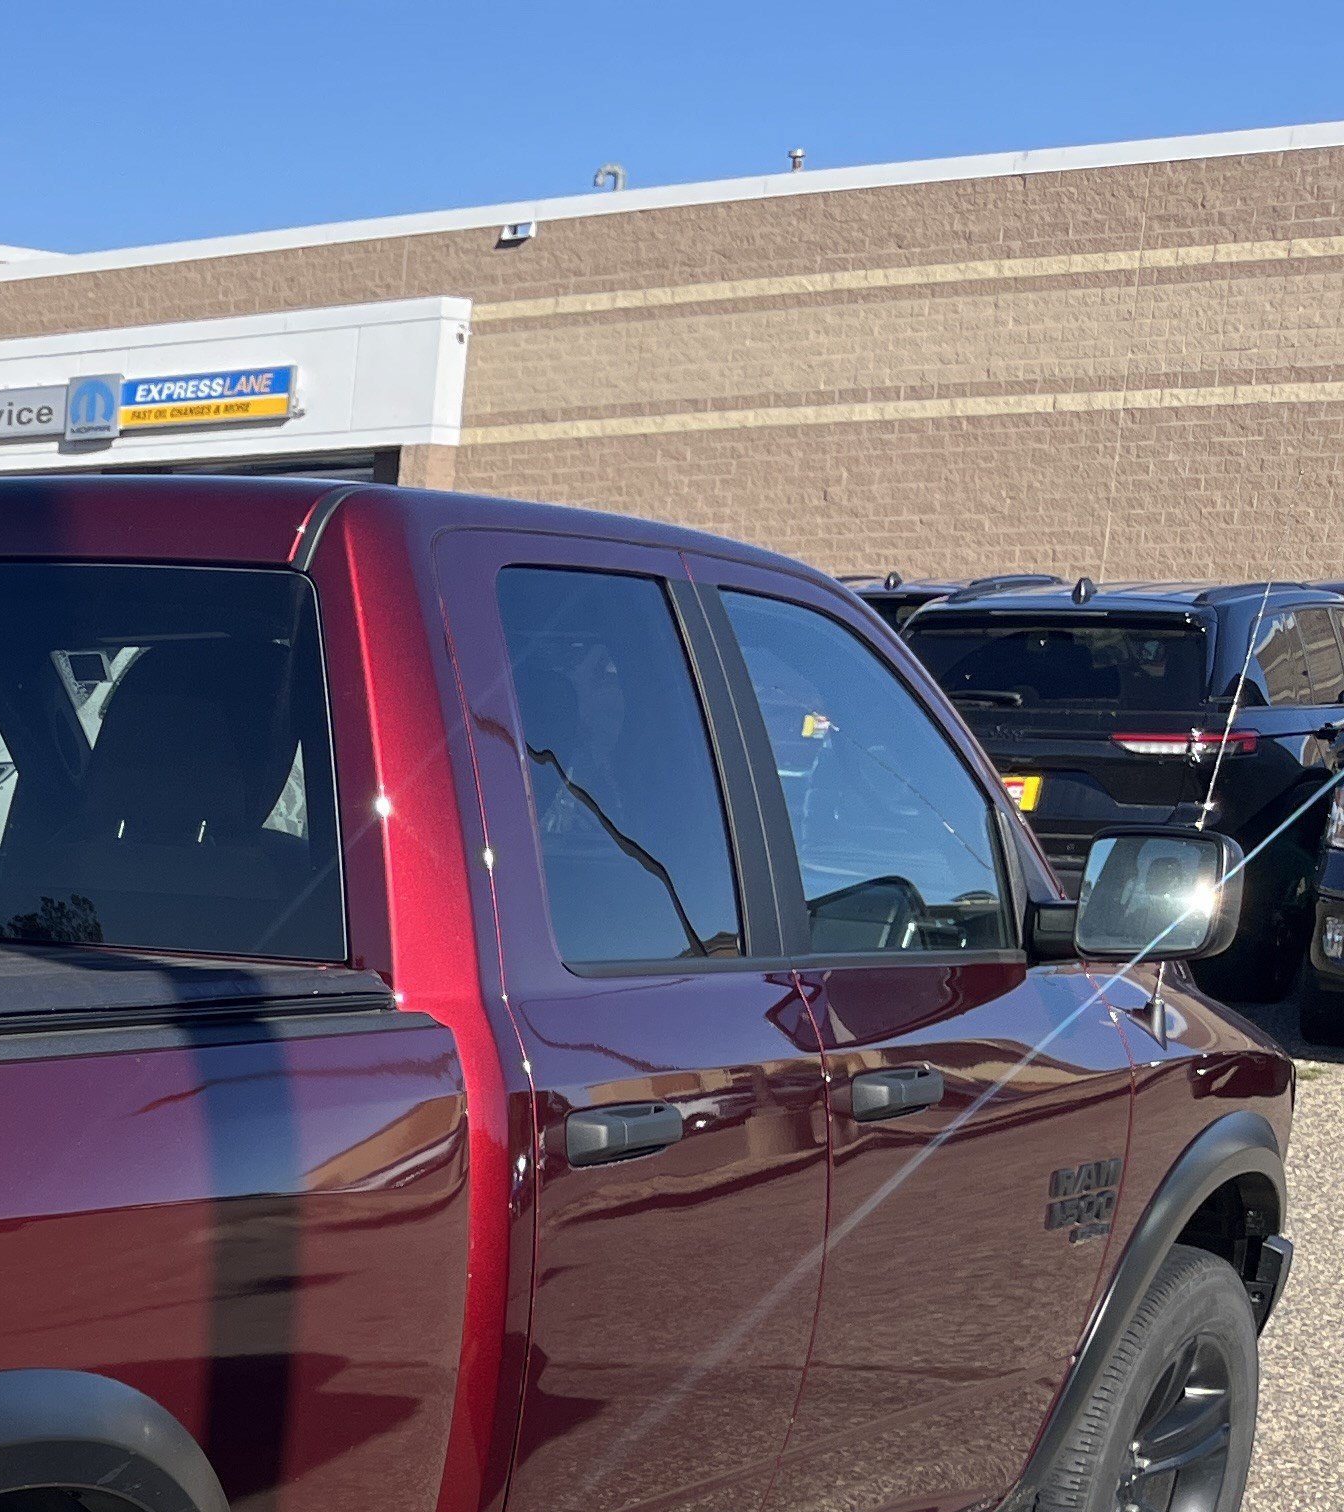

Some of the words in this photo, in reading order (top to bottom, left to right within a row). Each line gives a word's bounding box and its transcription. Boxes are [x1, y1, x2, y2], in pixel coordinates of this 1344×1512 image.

[135, 373, 273, 402] EXPRESSLANE
[130, 410, 152, 421] FAST
[170, 405, 212, 418] CHANGES
[222, 402, 251, 413] MORE
[1049, 1158, 1122, 1198] RAM
[1044, 1190, 1115, 1231] 1500
